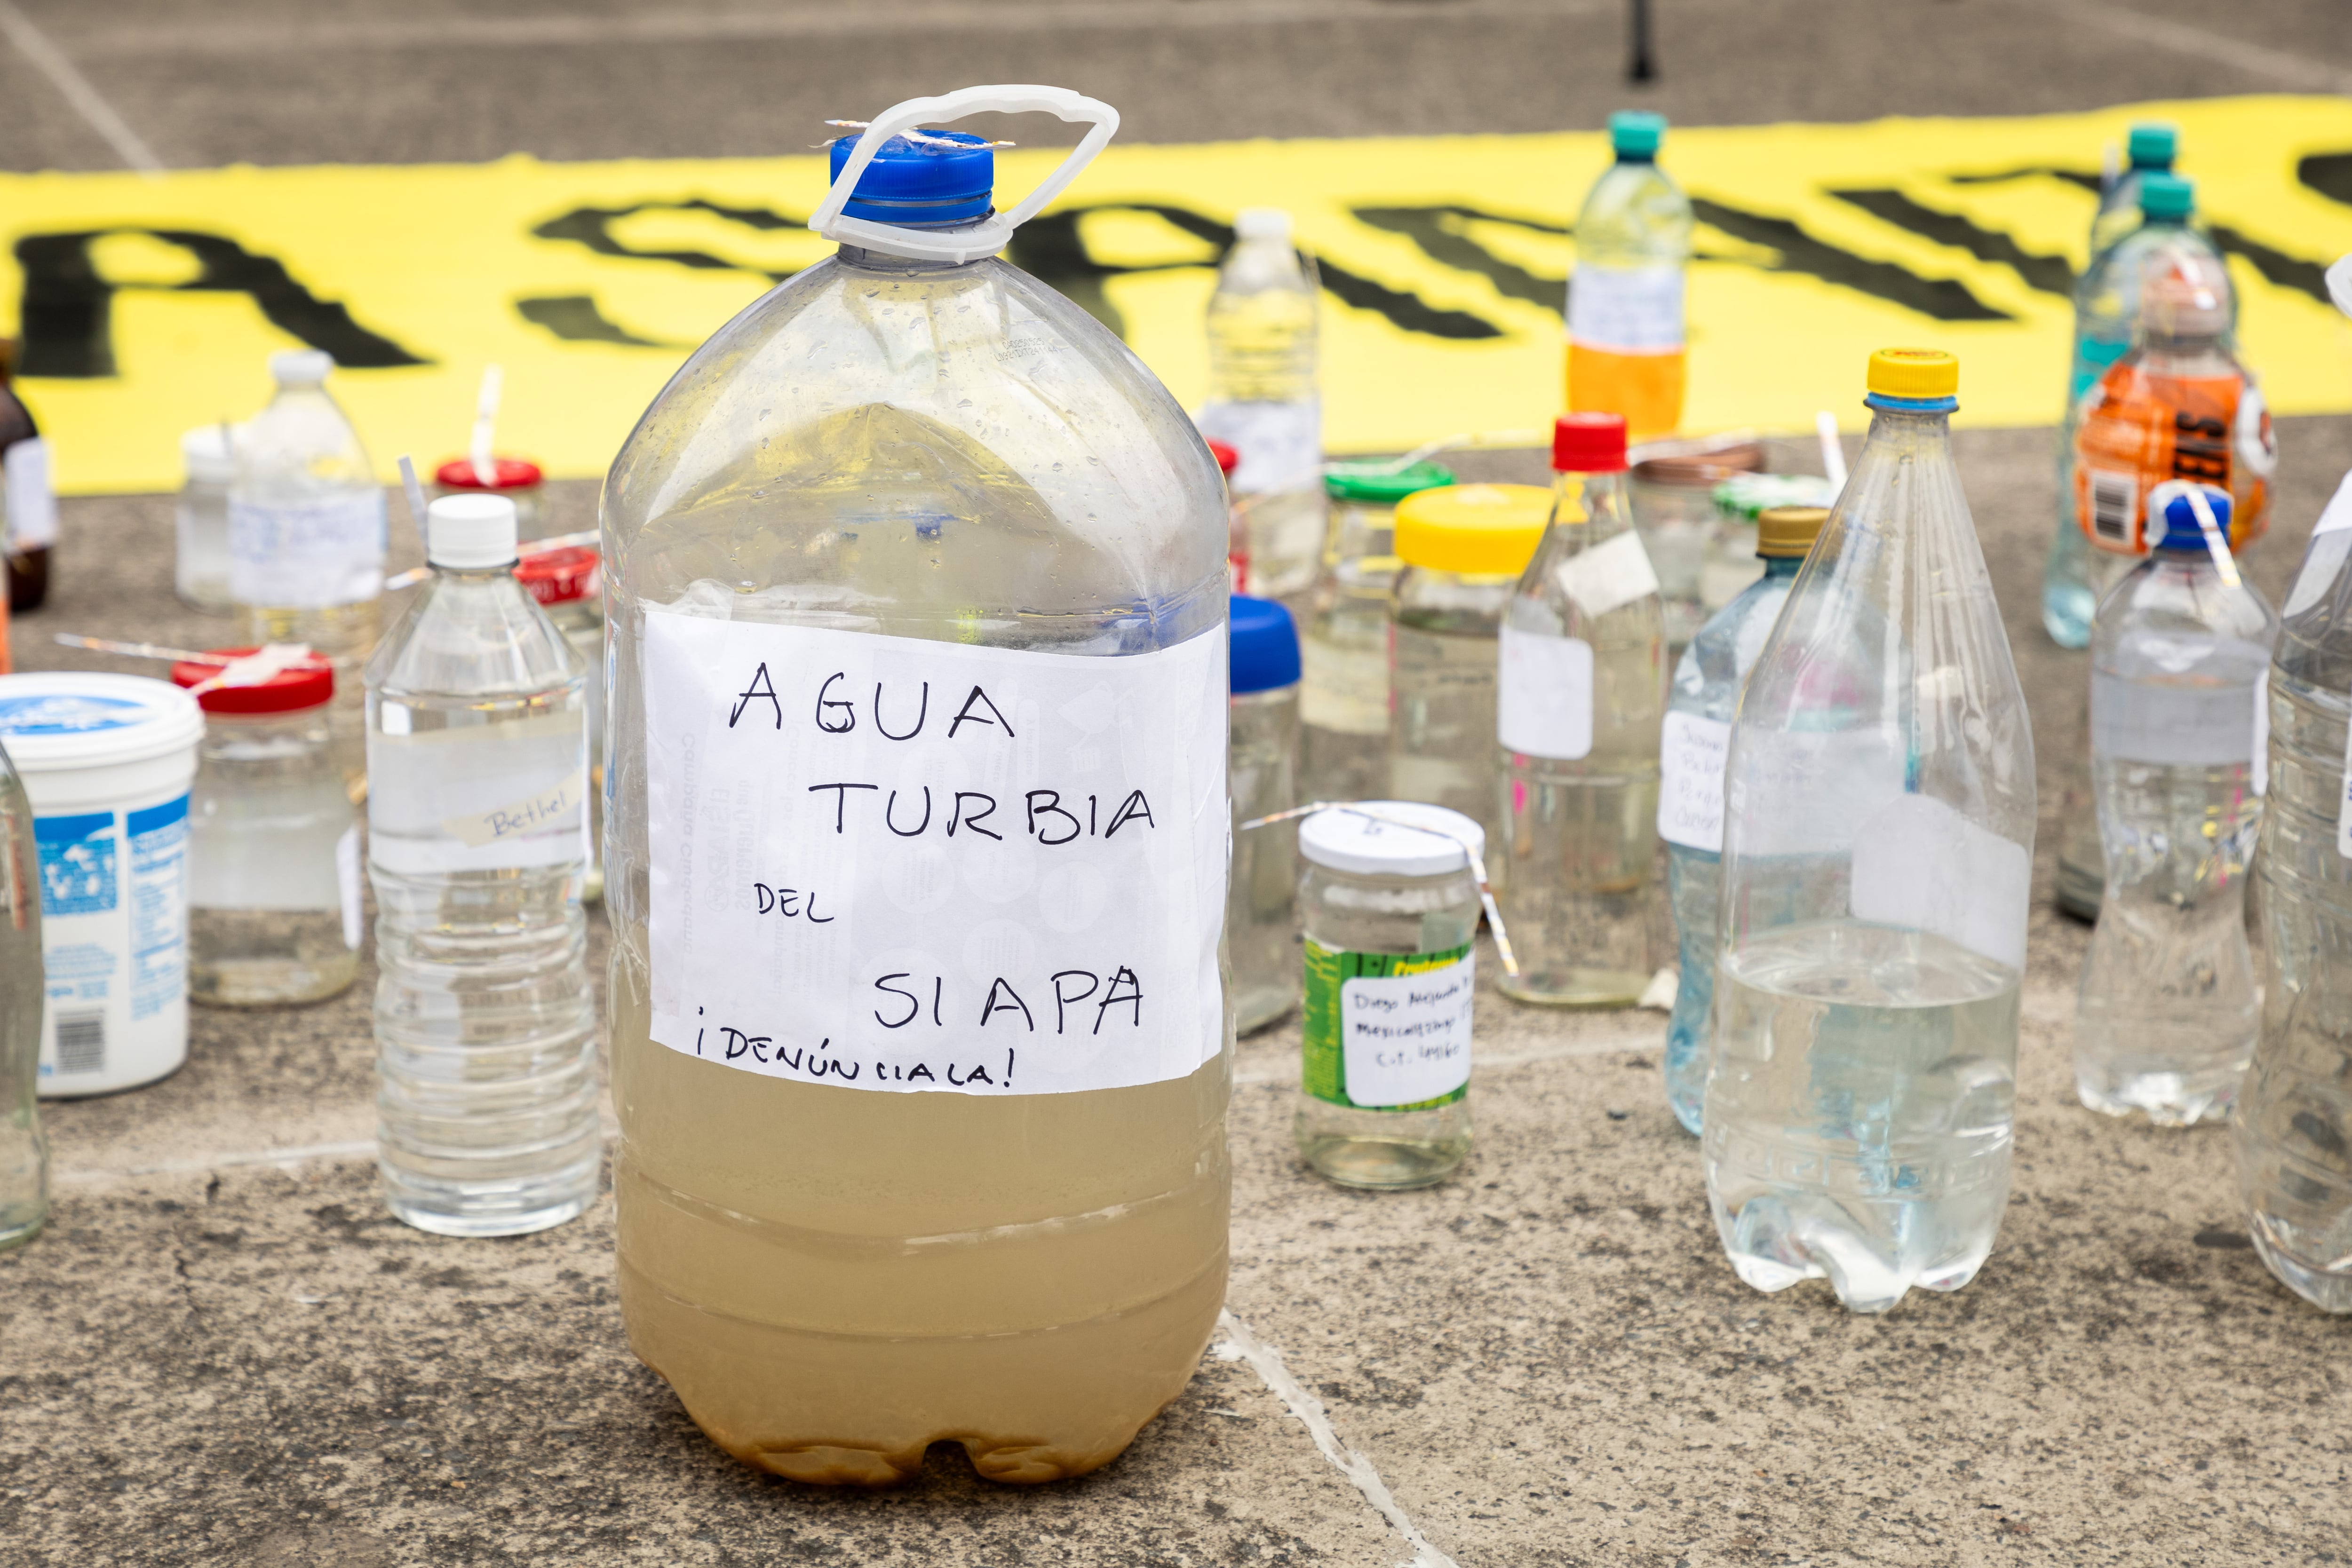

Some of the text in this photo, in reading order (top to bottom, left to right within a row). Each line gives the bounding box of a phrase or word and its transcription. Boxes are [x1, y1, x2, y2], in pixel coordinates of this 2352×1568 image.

[730, 663, 1014, 740] AGUA
[484, 791, 565, 837] Bethel
[809, 784, 1154, 845] TURBIA
[754, 883, 834, 922] DEL
